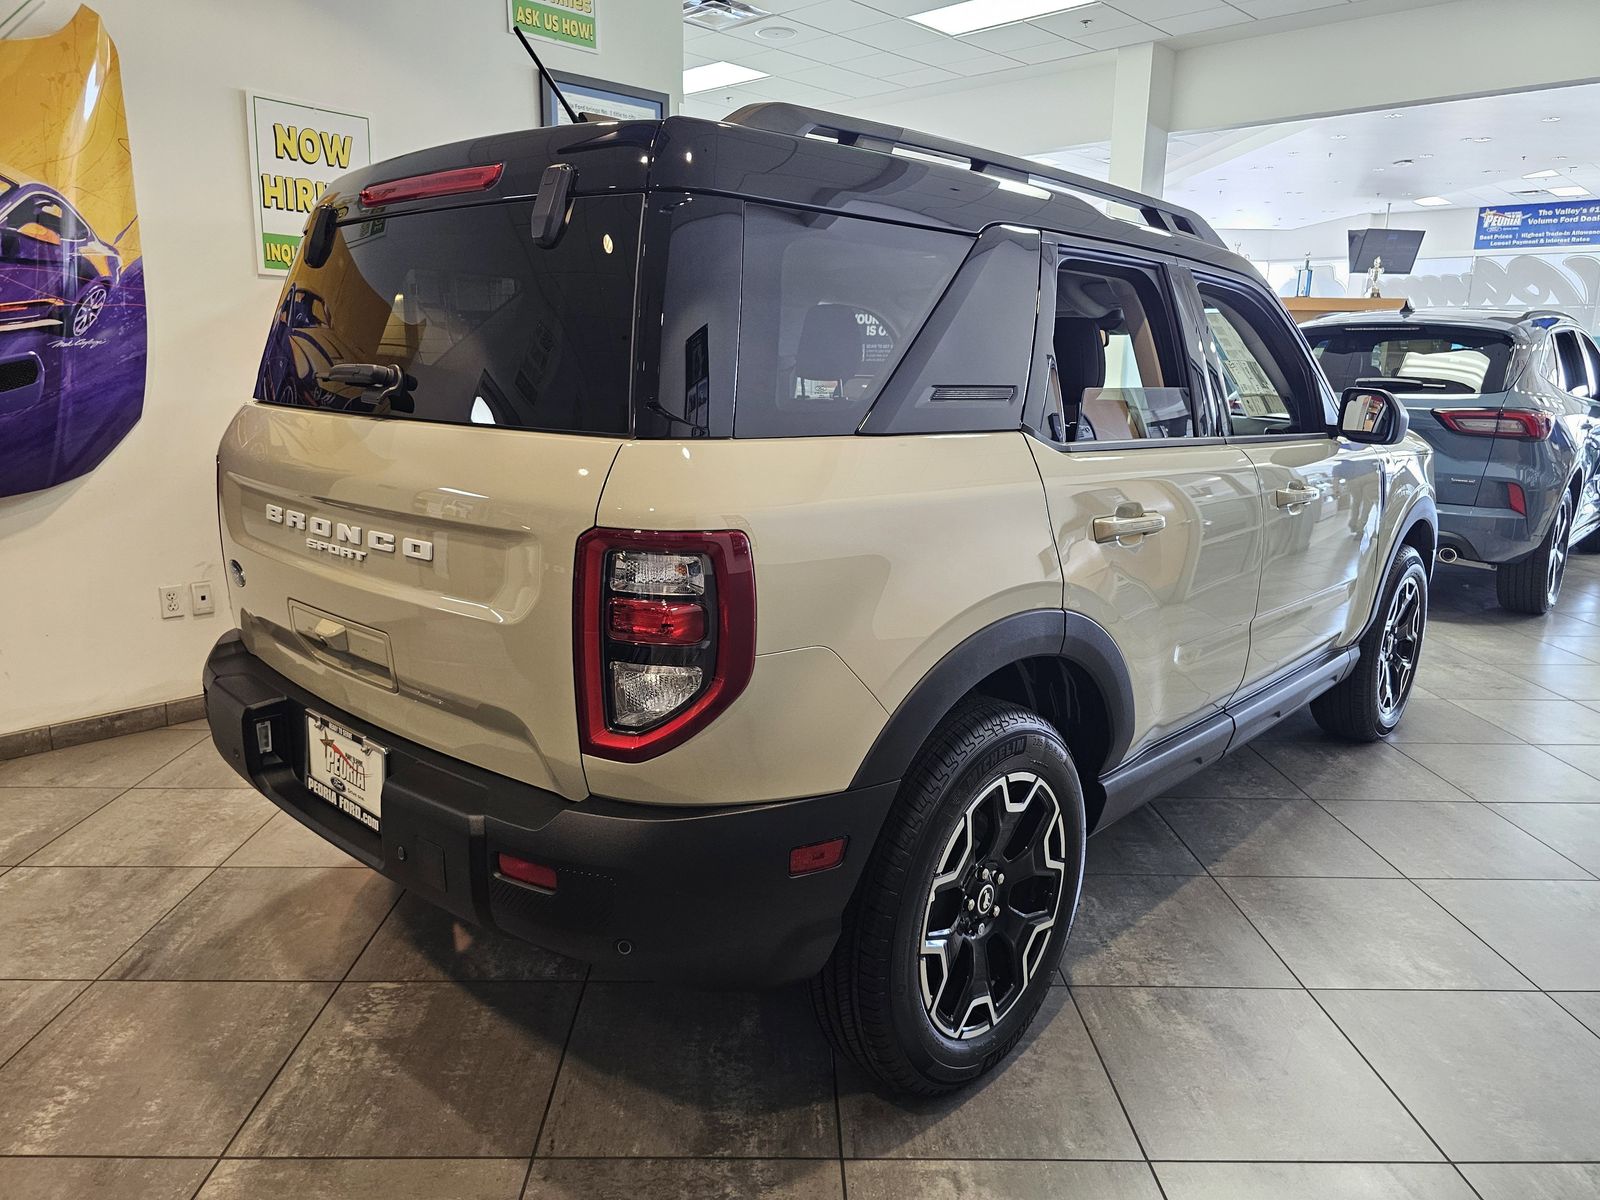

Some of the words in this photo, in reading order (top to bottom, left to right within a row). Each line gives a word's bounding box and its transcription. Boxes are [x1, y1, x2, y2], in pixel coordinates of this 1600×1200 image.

[516, 6, 541, 28] ASK
[543, 13, 559, 33] US
[562, 18, 594, 41] HOW!
[273, 123, 353, 169] NOW
[261, 173, 330, 214] HIRI
[1528, 217, 1558, 225] Volume
[1560, 216, 1579, 224] Ford
[1555, 208, 1587, 216] Valley's
[855, 314, 880, 325] OUR
[866, 325, 876, 336] IS
[266, 503, 433, 562] BRONCO
[306, 537, 368, 562] SPORT
[325, 750, 366, 791] PEORIA
[966, 739, 1025, 785] MICHELIN
[308, 777, 338, 805] PEORIA
